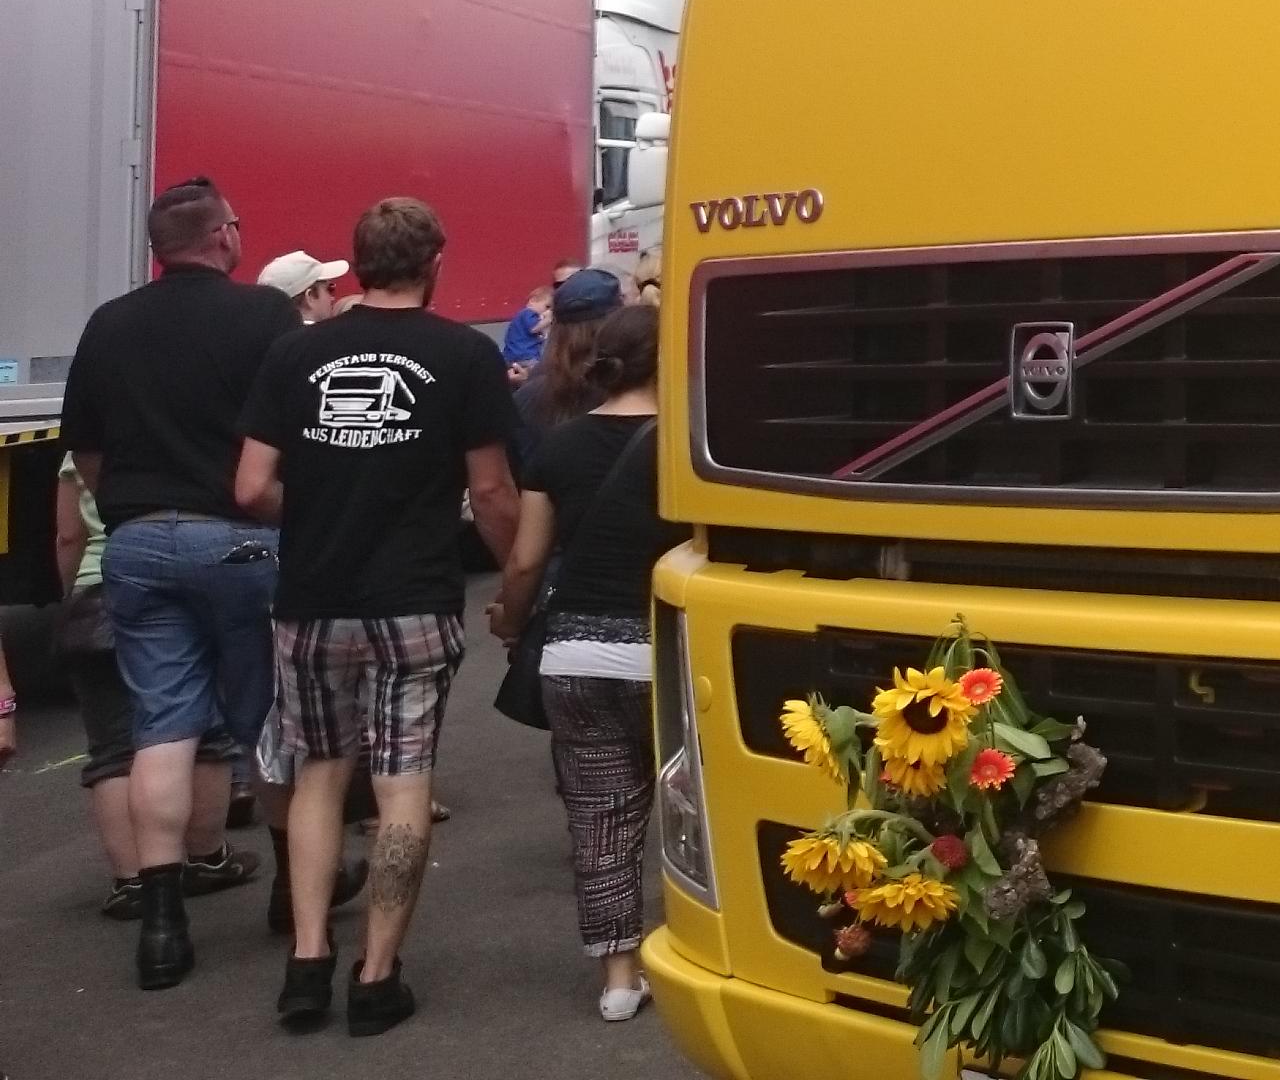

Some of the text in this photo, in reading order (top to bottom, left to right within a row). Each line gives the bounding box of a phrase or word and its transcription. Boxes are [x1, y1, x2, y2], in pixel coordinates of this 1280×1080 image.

[689, 187, 825, 236] VOLVO
[308, 353, 436, 384] FEINSTAUB TERRORIST
[1022, 366, 1066, 377] VOLVO
[303, 427, 328, 441] AUS
